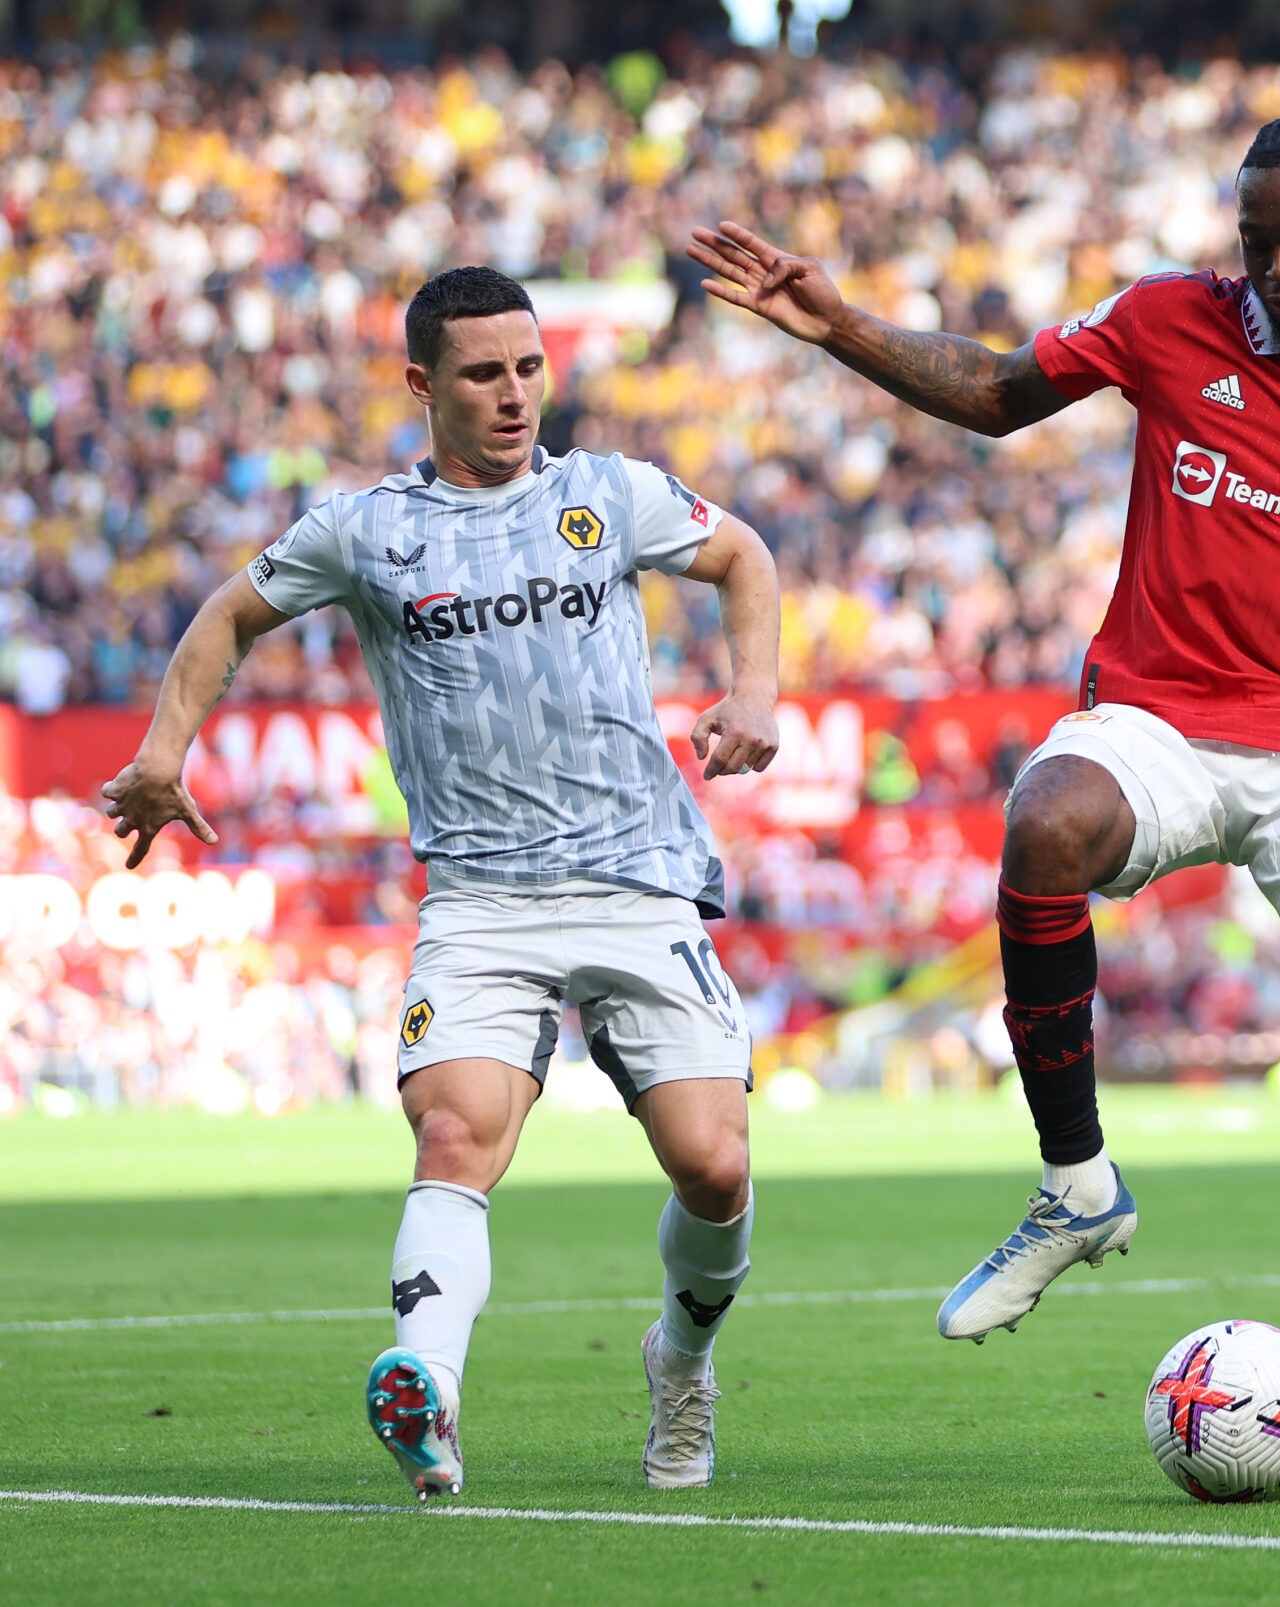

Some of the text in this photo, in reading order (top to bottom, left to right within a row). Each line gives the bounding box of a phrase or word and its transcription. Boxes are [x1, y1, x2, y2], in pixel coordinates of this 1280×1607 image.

[1201, 387, 1246, 410] adidas
[388, 566, 427, 578] CASTORE
[403, 577, 606, 645] AstroPay
